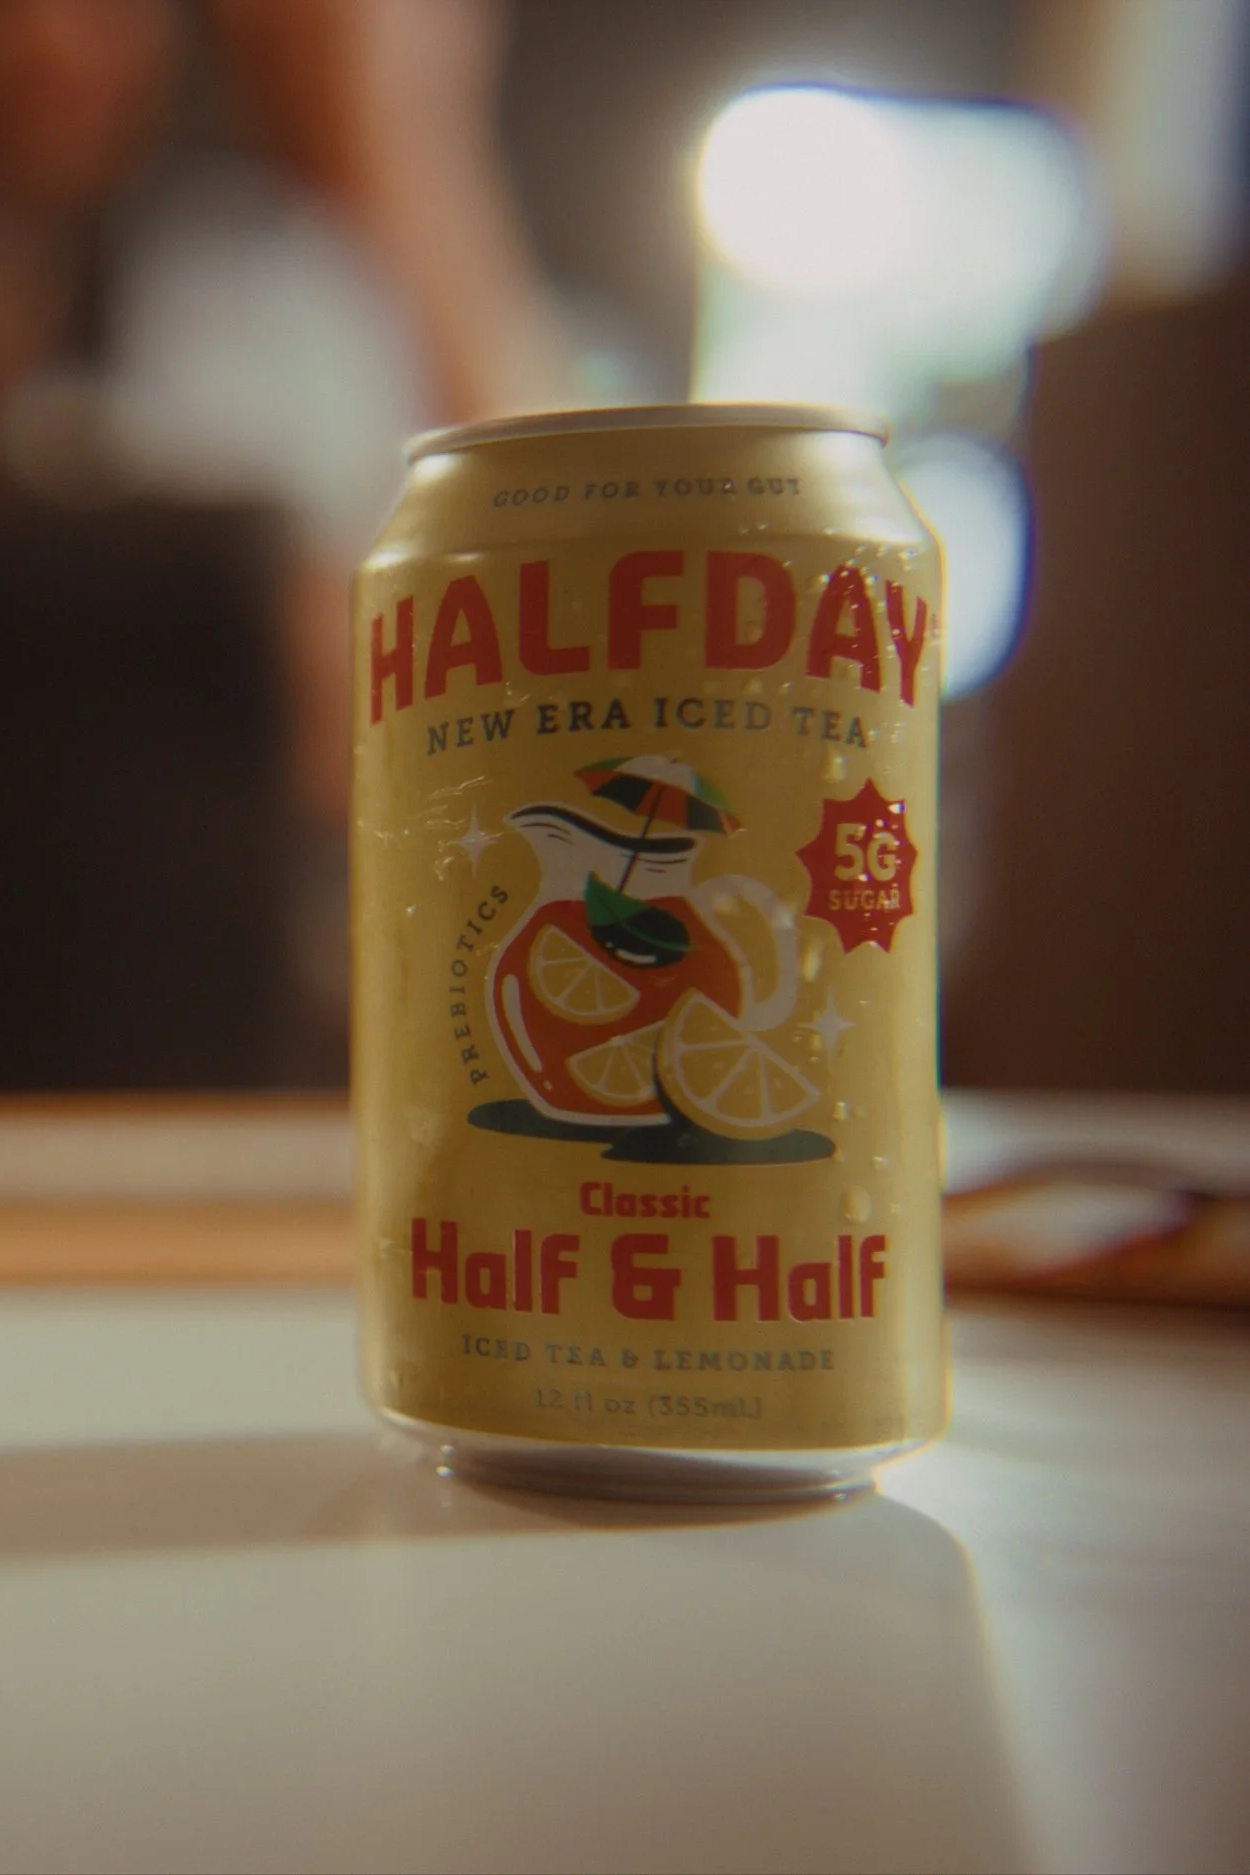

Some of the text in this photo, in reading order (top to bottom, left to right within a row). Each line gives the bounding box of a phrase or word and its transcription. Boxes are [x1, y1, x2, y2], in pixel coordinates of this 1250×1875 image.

[492, 484, 571, 508] GOOD
[583, 480, 641, 500] FOR
[369, 549, 928, 728] HALFDAY
[426, 697, 868, 755] NEW ERA ICED TEA
[833, 822, 899, 881] 5G
[827, 888, 901, 912] SUGAR
[450, 884, 509, 1087] PREBIOTICS
[579, 1181, 711, 1219] Classic
[410, 1217, 888, 1322] Half & Half
[461, 1333, 836, 1373] ICED TEA & LEMONADE
[535, 1388, 564, 1409] 12
[603, 1396, 636, 1415] oz
